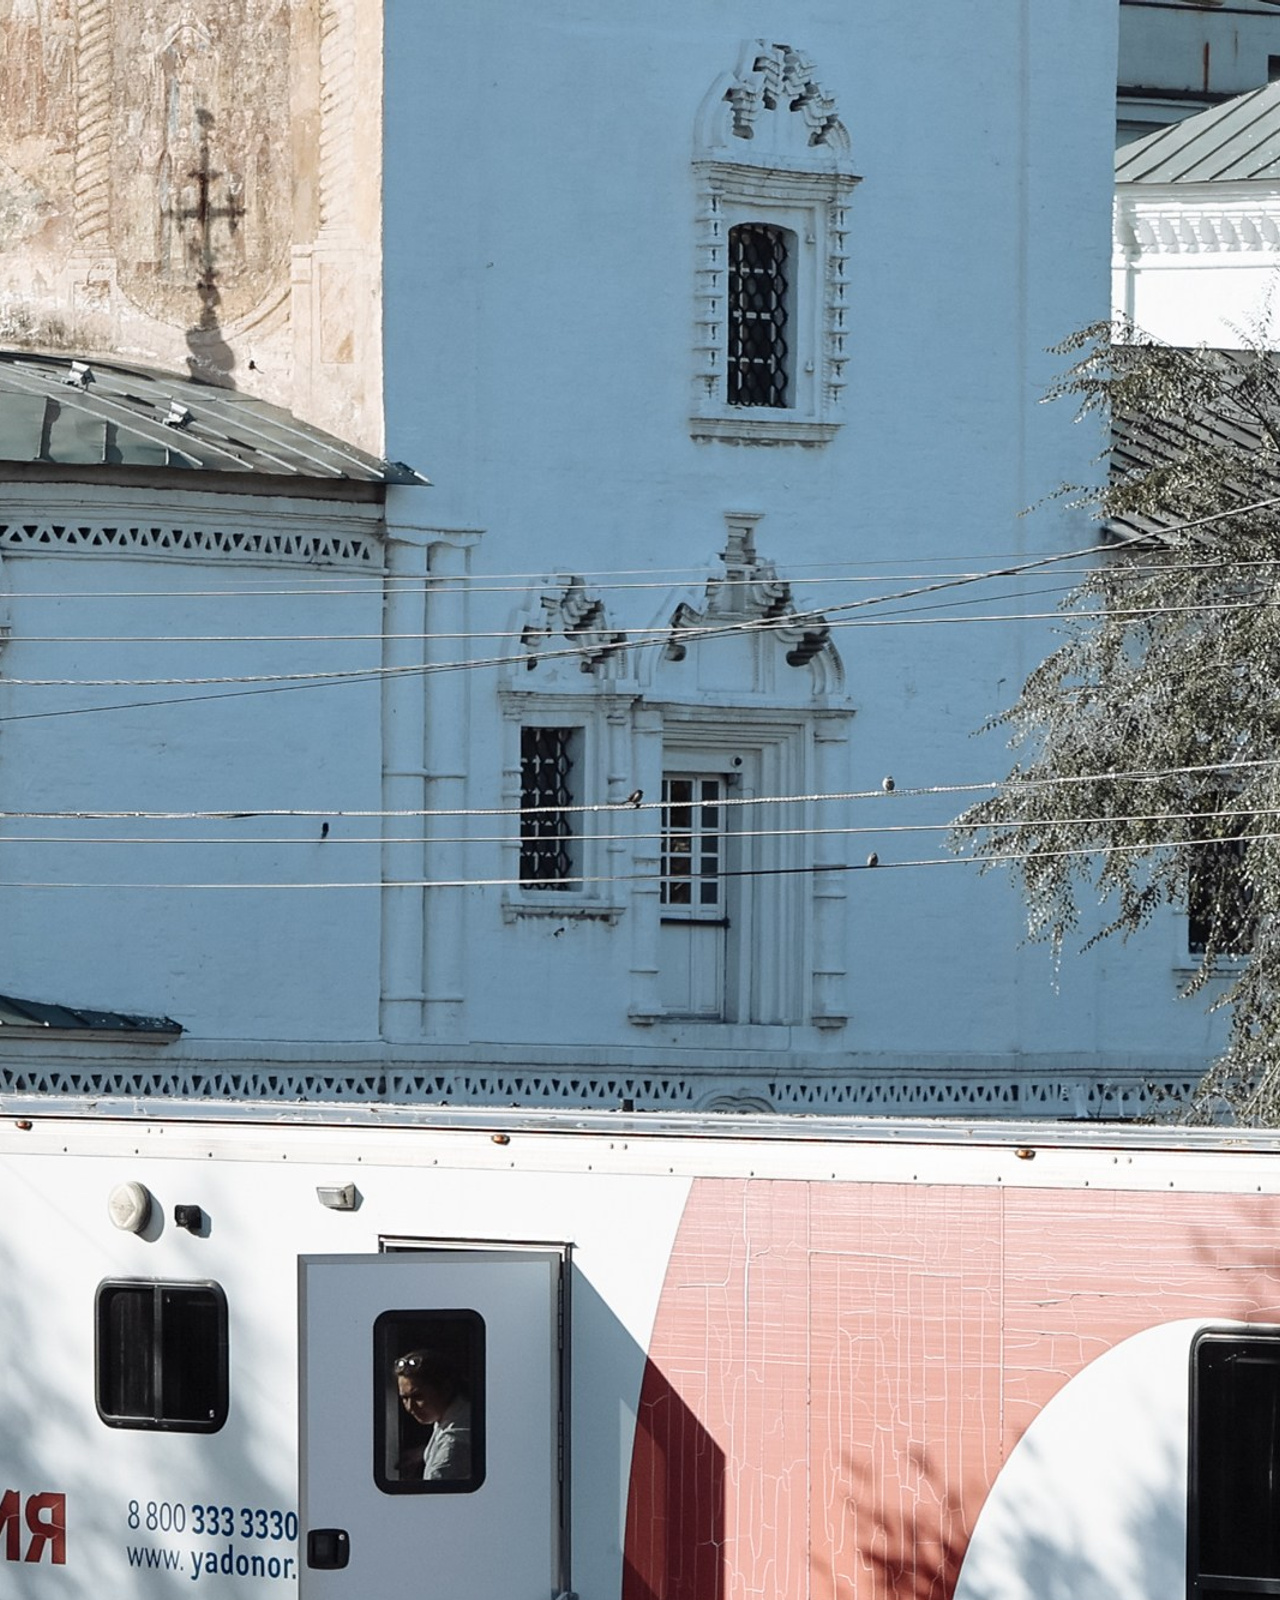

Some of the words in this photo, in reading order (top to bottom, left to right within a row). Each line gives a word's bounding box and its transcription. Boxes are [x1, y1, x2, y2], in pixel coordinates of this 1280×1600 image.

[127, 1499, 140, 1530] 8
[145, 1501, 186, 1533] 800
[191, 1504, 235, 1537] 333
[240, 1507, 298, 1542] 3330
